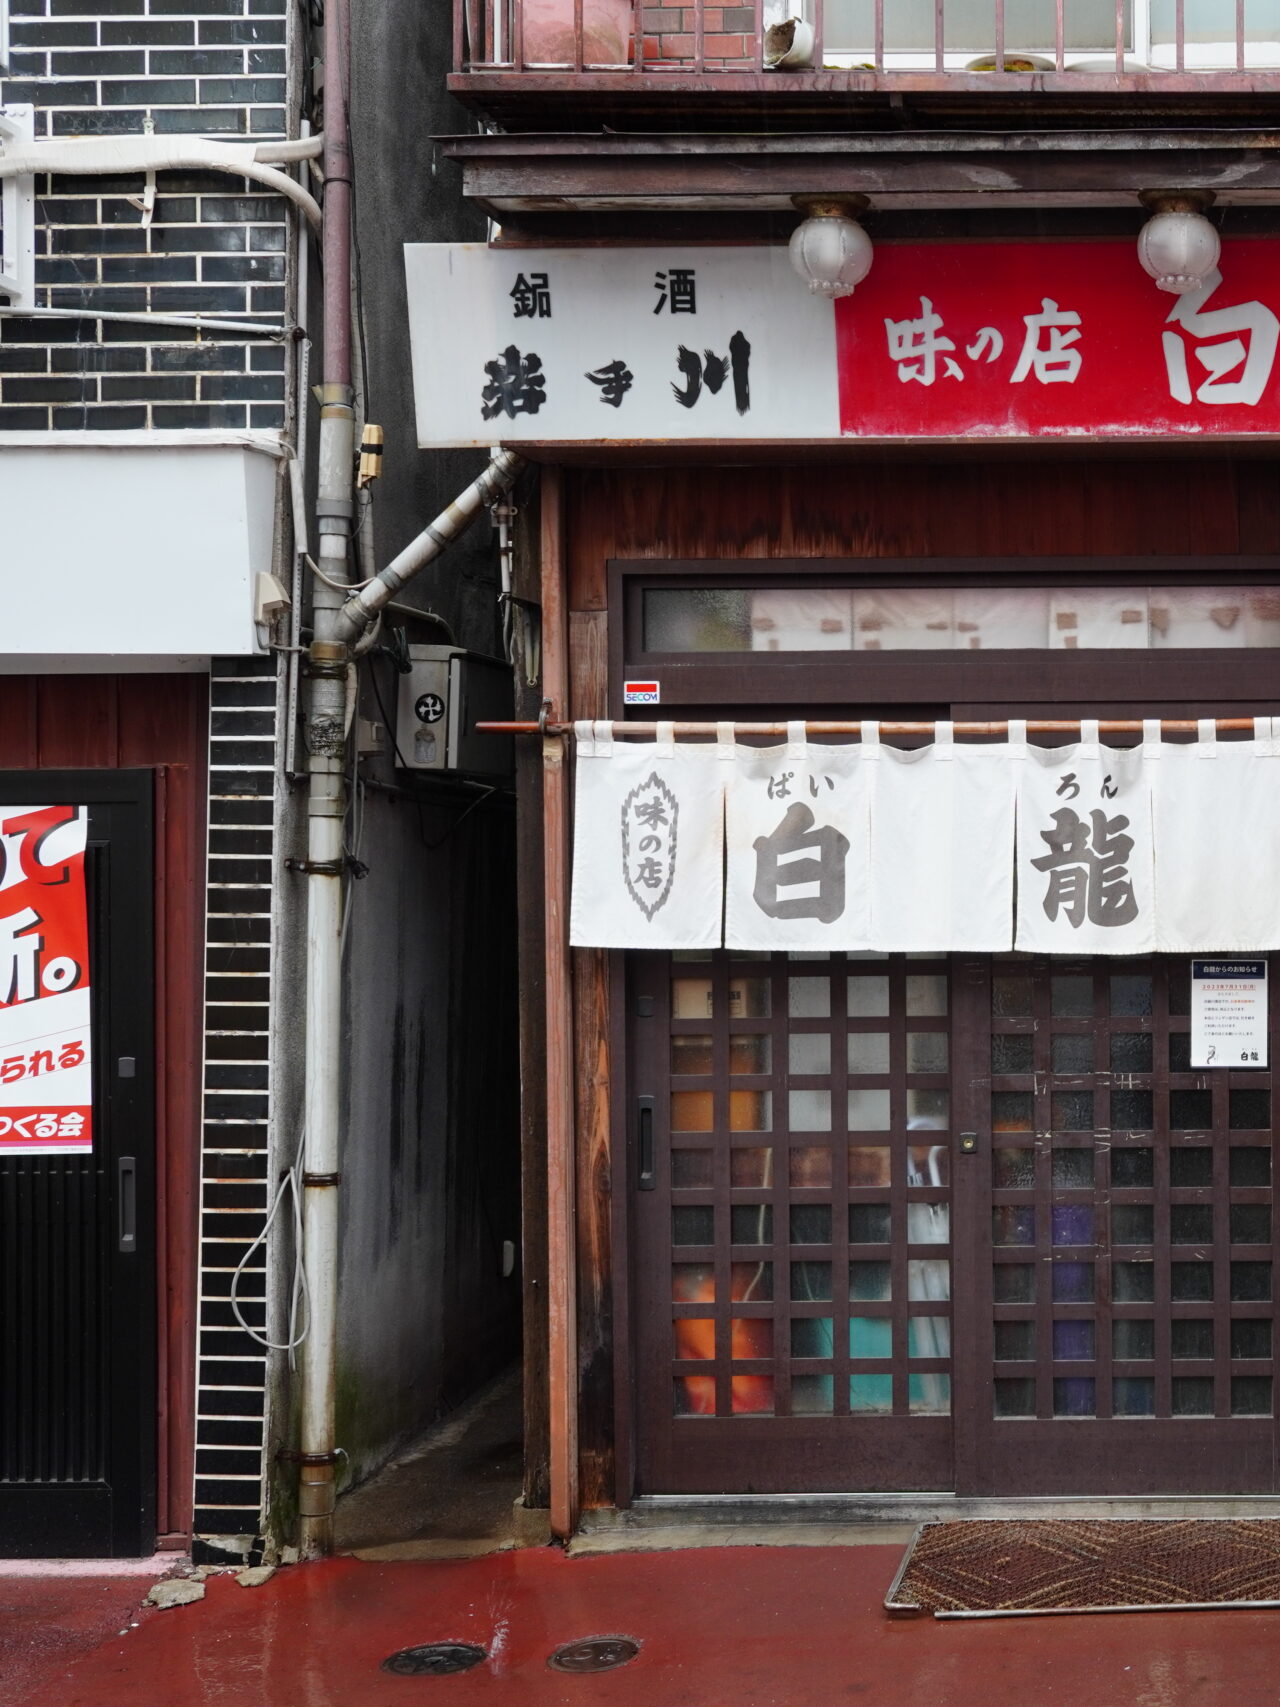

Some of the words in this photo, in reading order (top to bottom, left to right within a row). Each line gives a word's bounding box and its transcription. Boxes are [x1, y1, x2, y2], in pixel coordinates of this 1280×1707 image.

[883, 295, 1083, 388] 味の店
[626, 693, 658, 701] SECOM
[633, 796, 669, 889] 味の店
